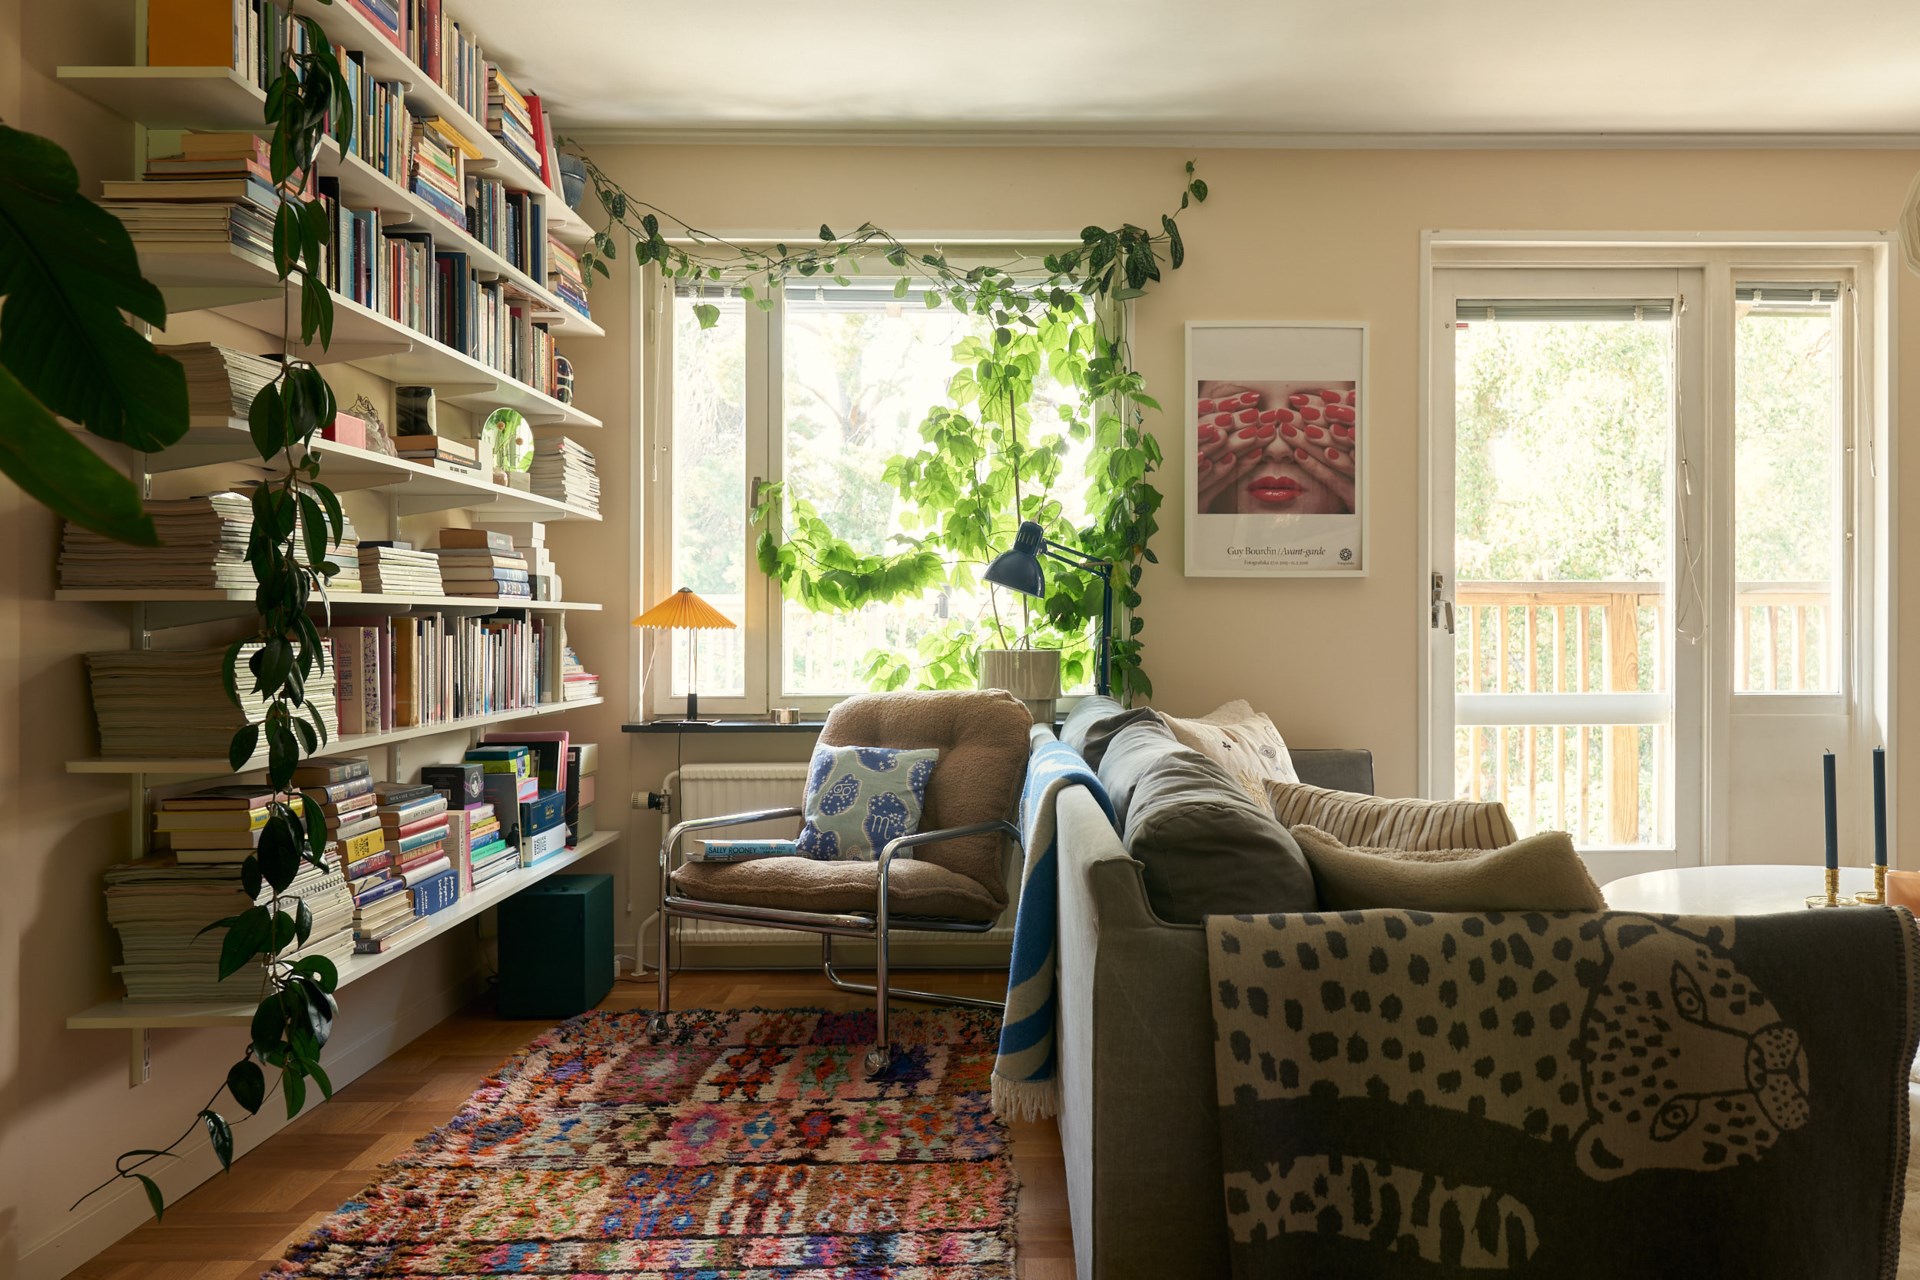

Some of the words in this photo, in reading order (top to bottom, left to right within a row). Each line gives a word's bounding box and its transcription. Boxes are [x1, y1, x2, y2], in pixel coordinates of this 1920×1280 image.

[1227, 546, 1243, 557] Guy
[1245, 546, 1277, 556] Bourdin
[728, 846, 757, 854] ROONEY
